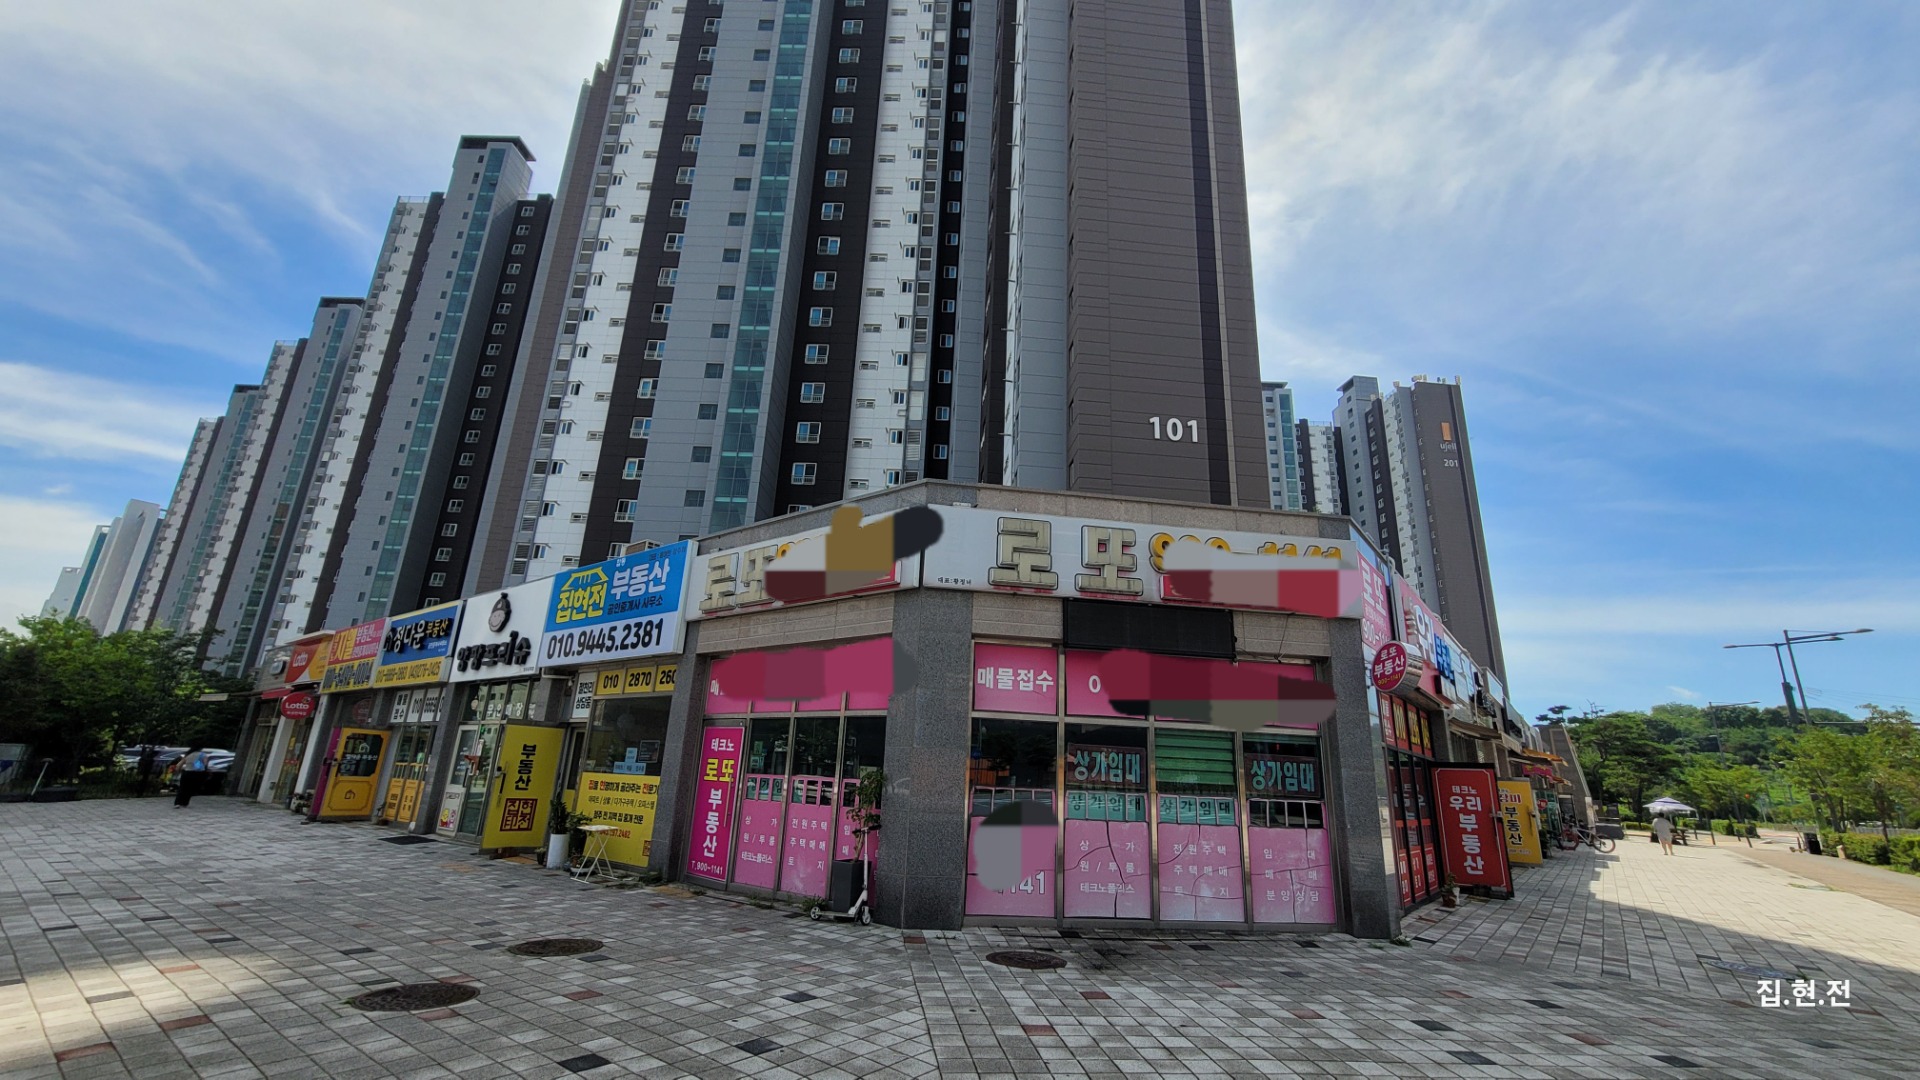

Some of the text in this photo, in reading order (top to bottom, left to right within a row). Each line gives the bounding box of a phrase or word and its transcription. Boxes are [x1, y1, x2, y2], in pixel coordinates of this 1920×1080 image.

[1149, 416, 1198, 442] 101
[1443, 459, 1458, 467] 201
[988, 516, 1145, 597] 로또
[611, 558, 670, 600] 부동산
[555, 582, 608, 624] 집현전
[393, 620, 449, 653] 정다운 부동산
[546, 617, 664, 660] 010.9445.2381
[1380, 646, 1397, 661] 로또
[1373, 654, 1404, 679] 부동산
[604, 674, 619, 689] 010
[628, 671, 652, 687] 2870
[977, 666, 1054, 692] 매물접수
[285, 701, 309, 710] Lotto
[394, 708, 405, 720] 접수
[576, 697, 592, 709] 상담중
[711, 737, 734, 752] 테크노
[514, 744, 537, 791] 부동산
[703, 758, 735, 782] 로또
[1074, 750, 1140, 783] 상가임대
[1250, 758, 1315, 792] 상가임대
[1452, 785, 1477, 795] 테크노
[1160, 799, 1231, 816] 상가임대
[1449, 796, 1482, 812] 우리
[703, 788, 723, 858] 부동산
[1504, 806, 1523, 846] 부동산
[1459, 813, 1484, 875] 부동산
[691, 860, 723, 875] T.900-1141
[741, 850, 773, 865] 테크노폴리스
[1079, 882, 1136, 895] 테크노폴리스
[1266, 889, 1320, 902] 분양상담
